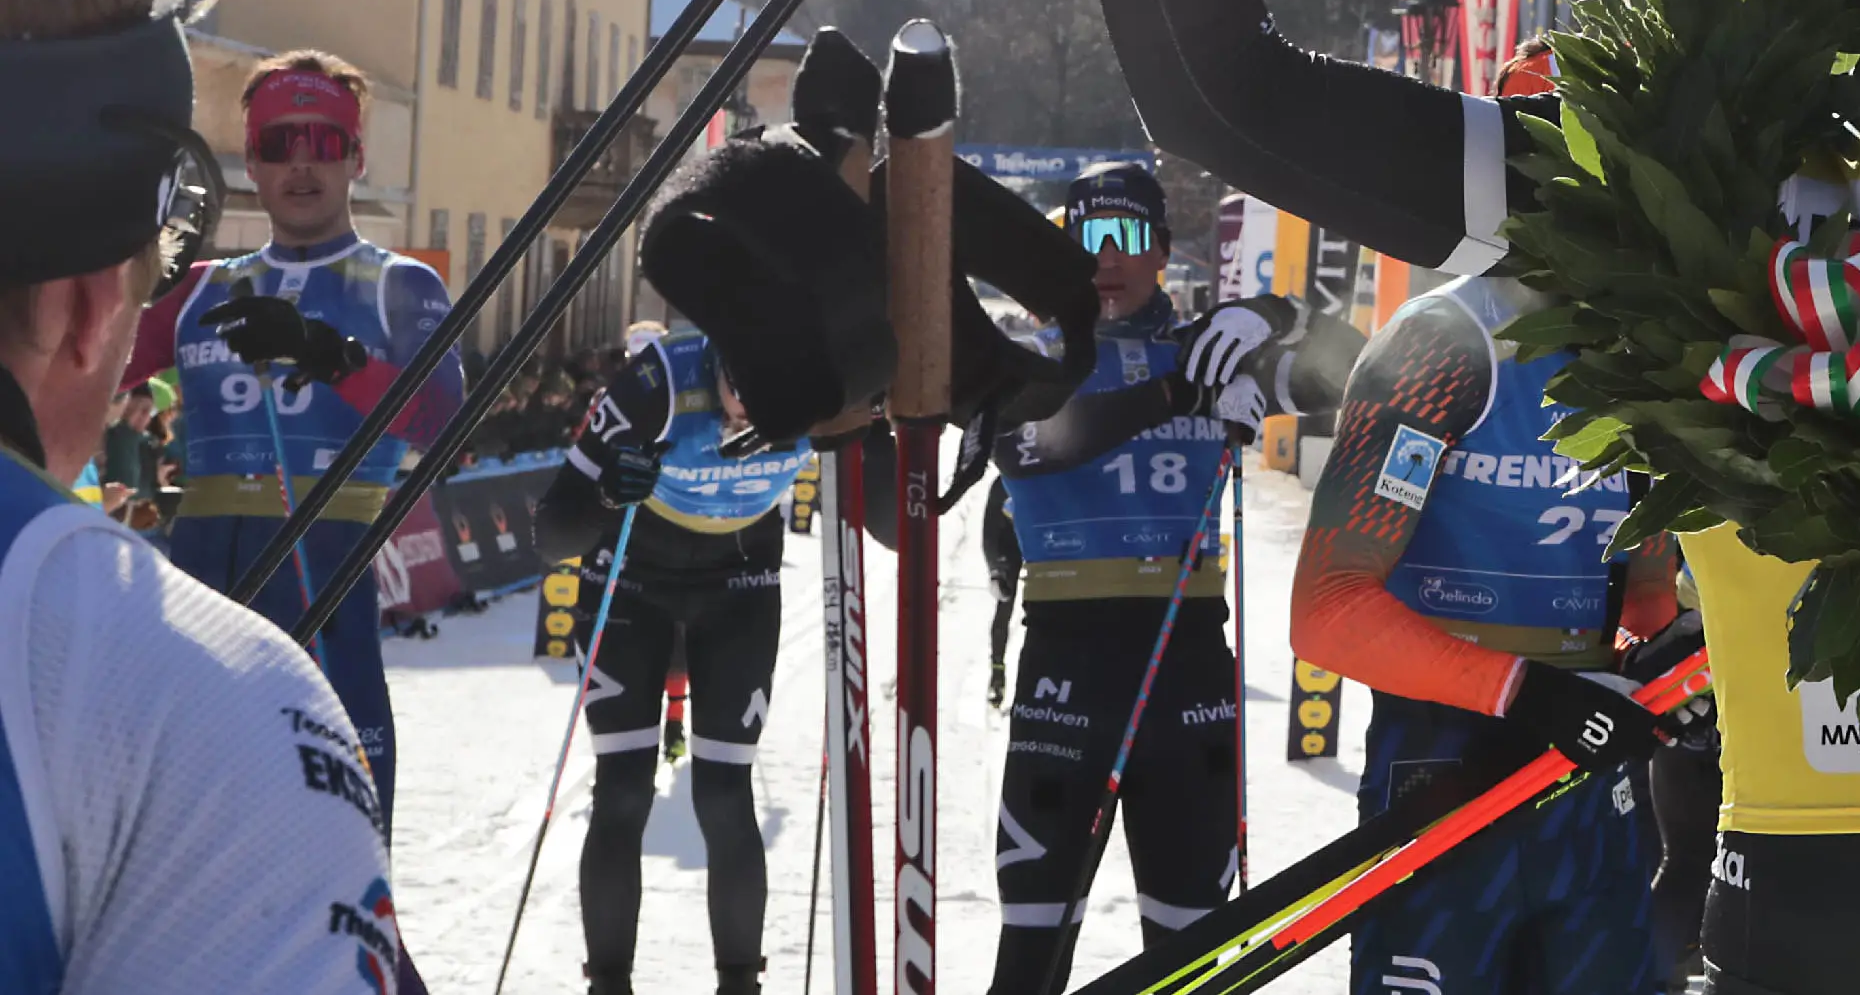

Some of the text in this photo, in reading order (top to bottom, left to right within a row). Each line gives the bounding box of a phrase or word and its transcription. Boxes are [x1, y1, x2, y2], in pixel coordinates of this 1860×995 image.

[1091, 195, 1150, 216] Moelven
[219, 372, 314, 416] 90
[1102, 452, 1189, 495] 18
[907, 469, 928, 520] TCS
[1379, 477, 1425, 507] Koteng
[1012, 703, 1090, 728] Moelven
